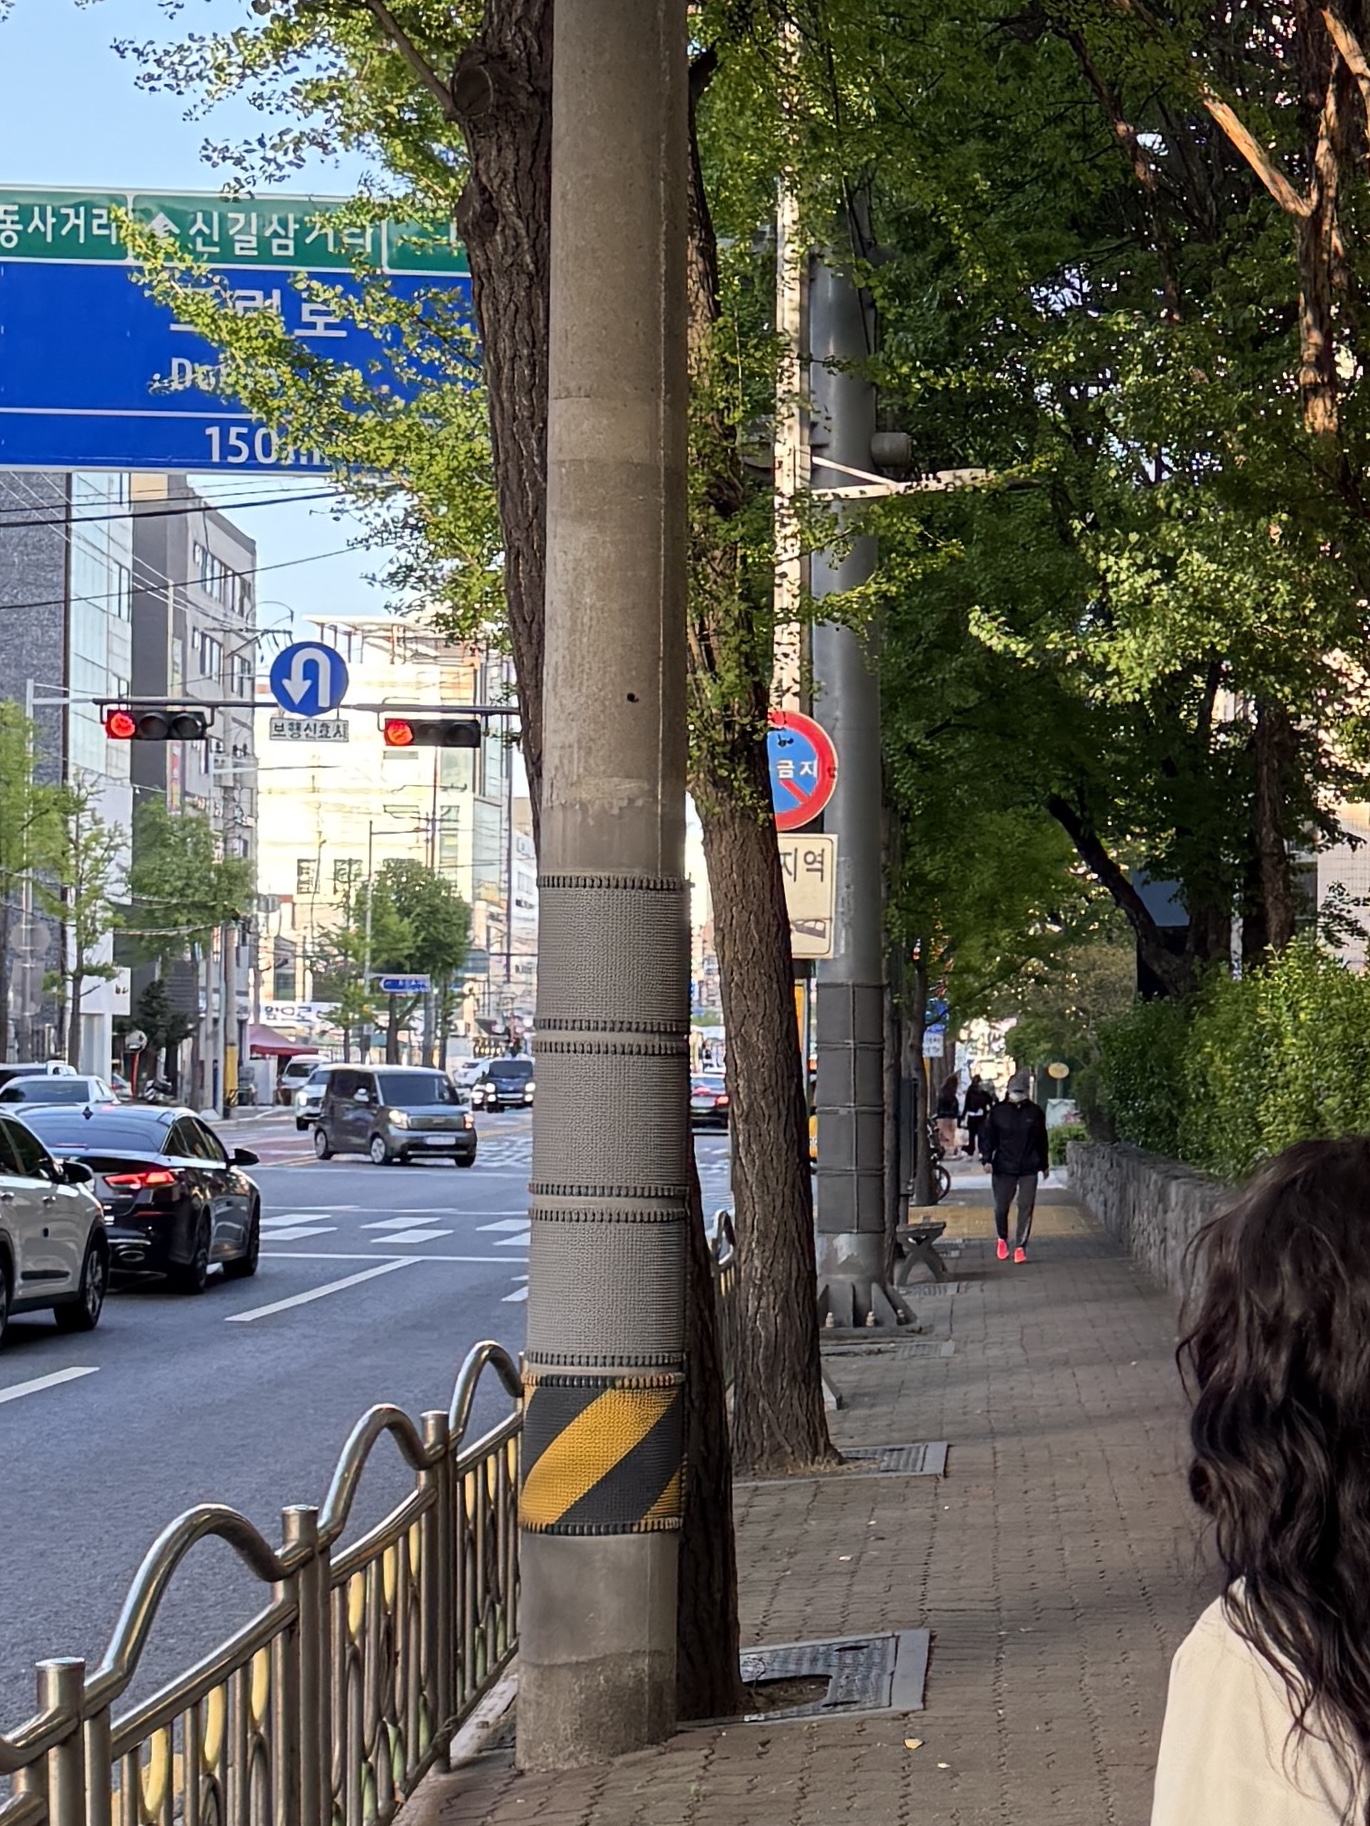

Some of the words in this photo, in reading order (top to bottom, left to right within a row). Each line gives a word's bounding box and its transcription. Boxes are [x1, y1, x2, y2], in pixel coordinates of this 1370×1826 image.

[0, 204, 117, 248] 동사거리
[271, 721, 348, 739] 보행신호시
[777, 759, 818, 779] 금지
